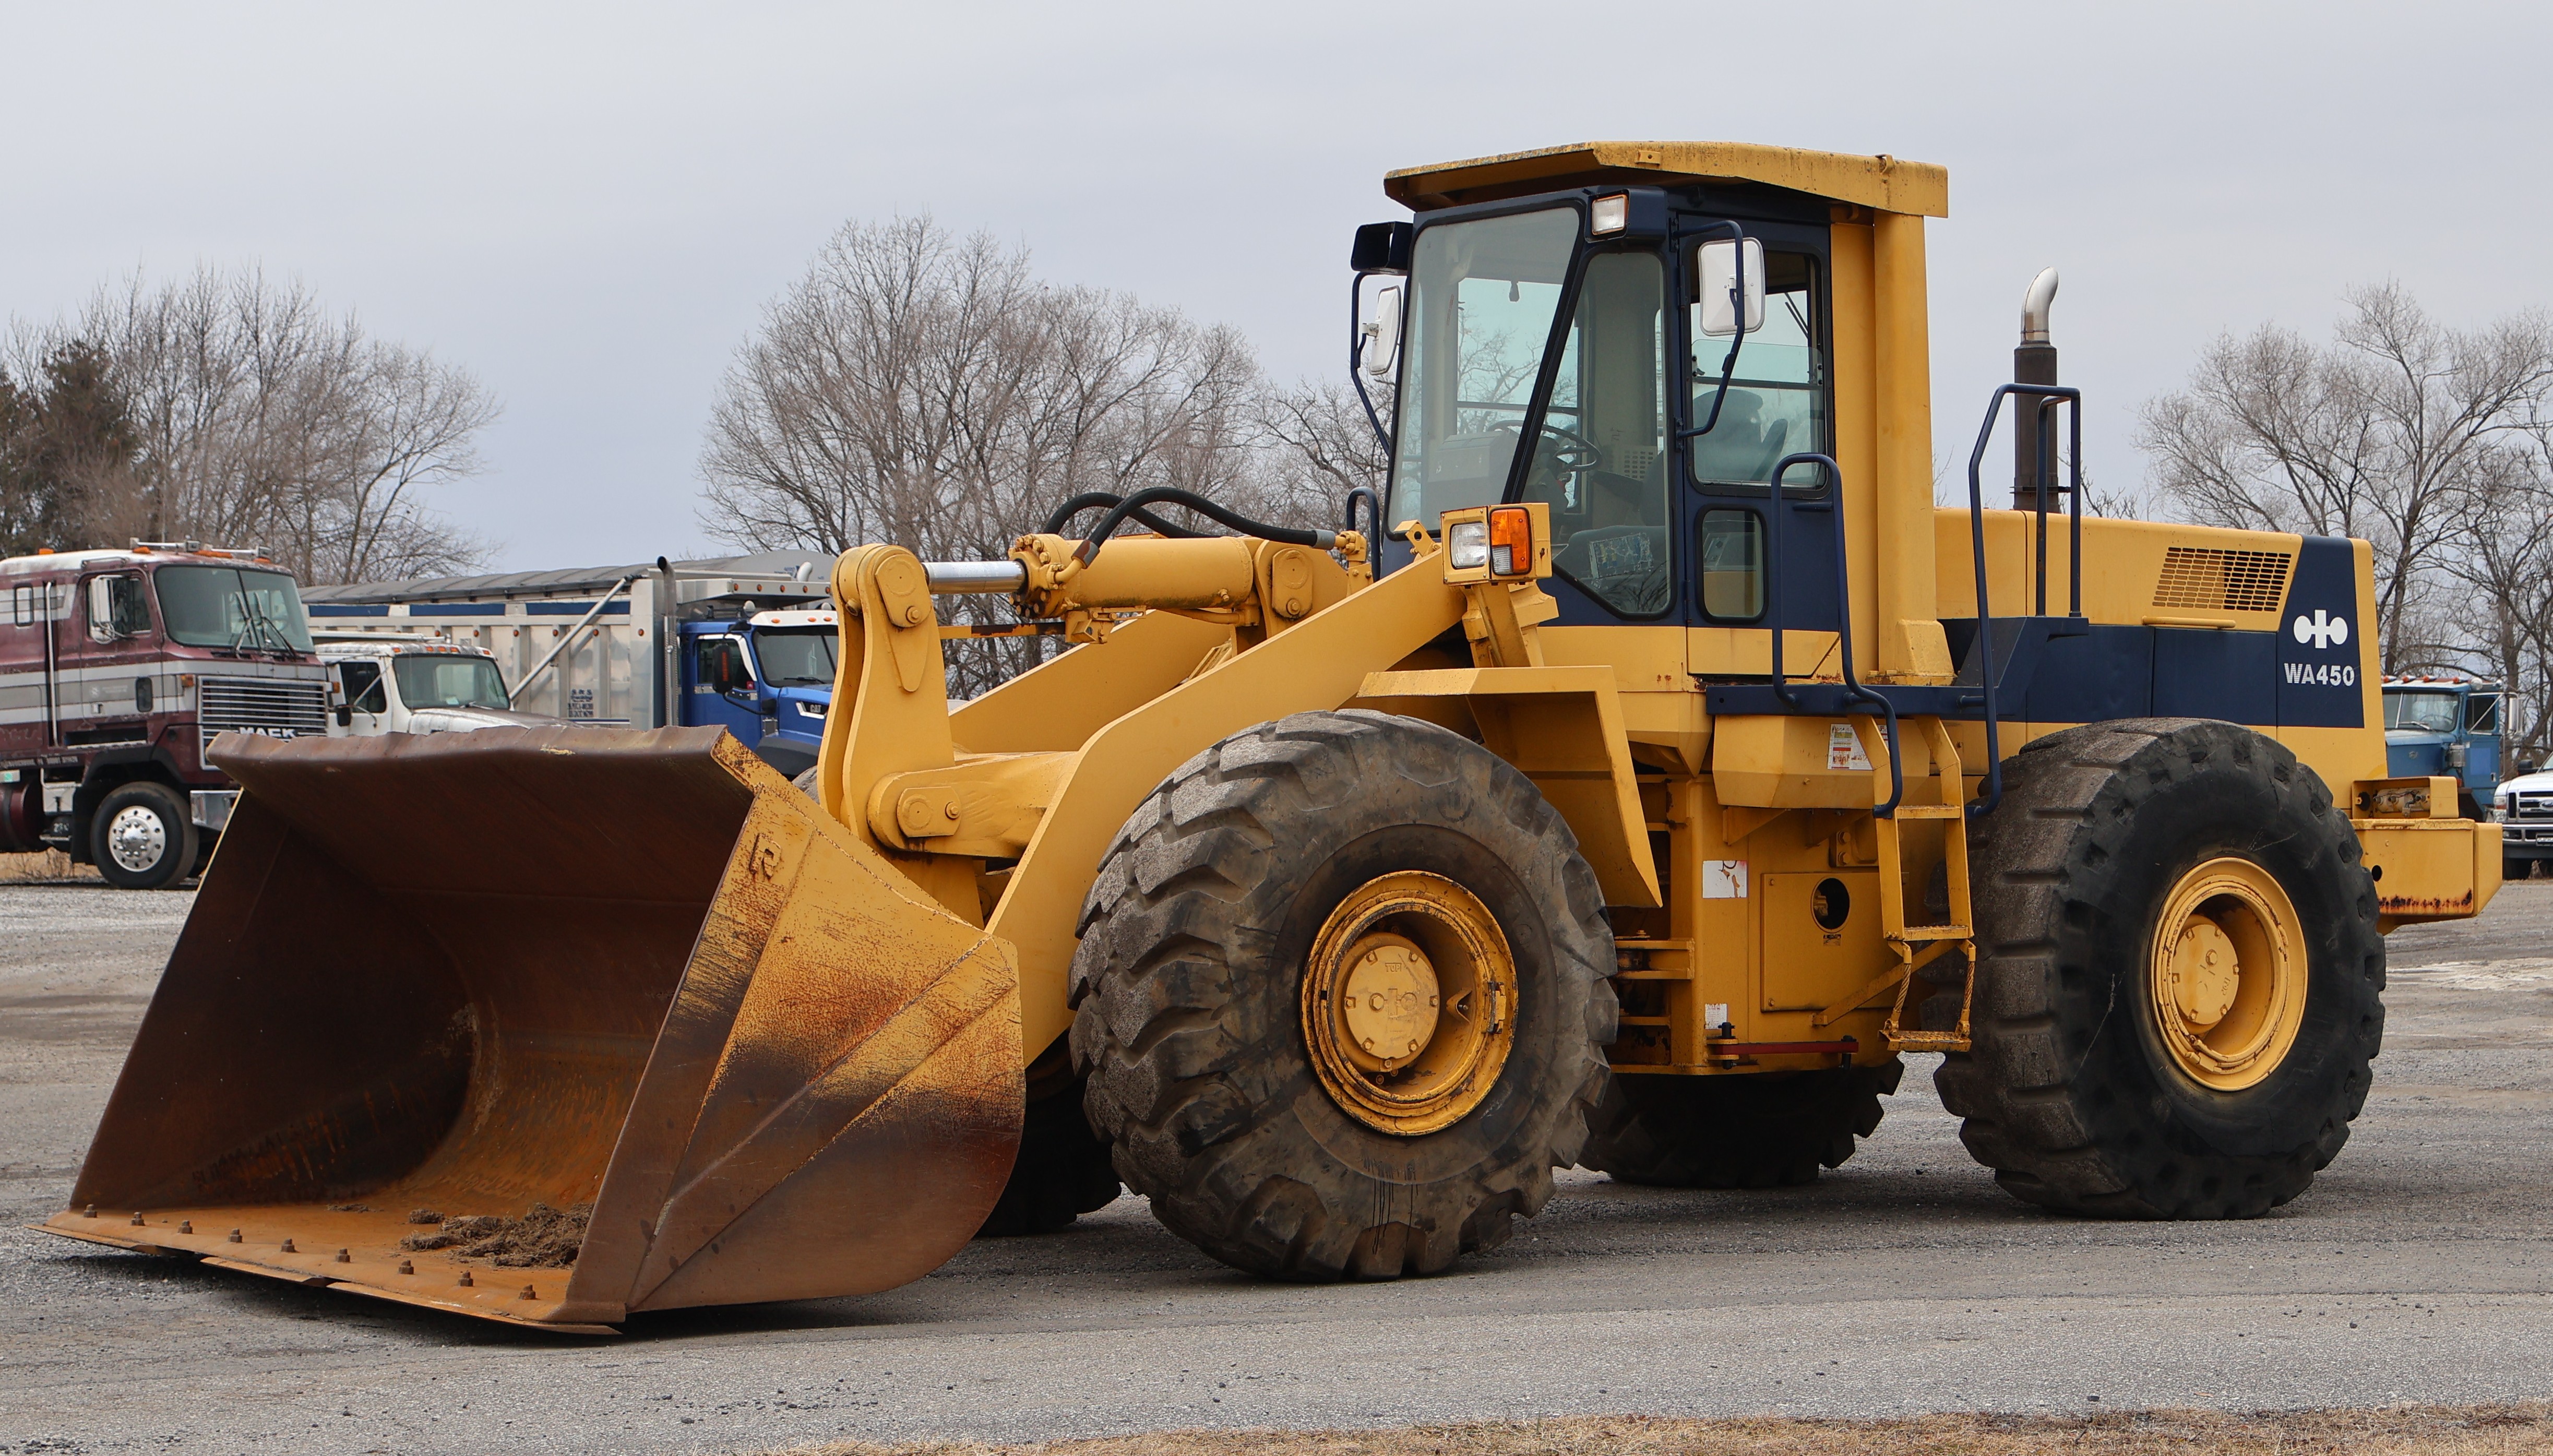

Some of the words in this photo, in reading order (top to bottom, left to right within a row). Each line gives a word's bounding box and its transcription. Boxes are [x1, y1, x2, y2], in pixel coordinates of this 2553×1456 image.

[2284, 663, 2355, 686] WA450
[810, 705, 822, 713] CAT
[239, 726, 297, 738] MACK
[1385, 962, 1402, 973] TOP
